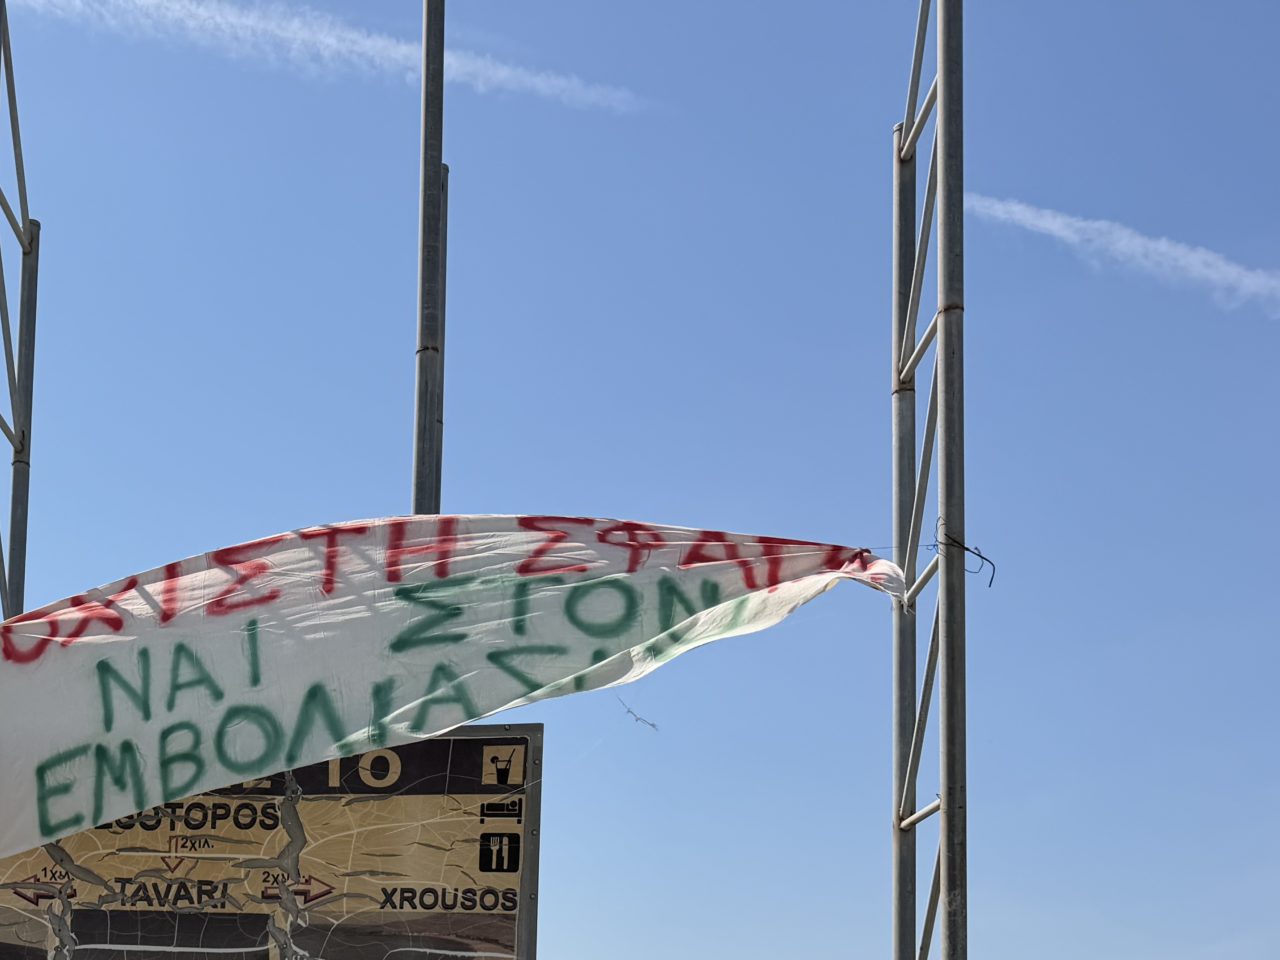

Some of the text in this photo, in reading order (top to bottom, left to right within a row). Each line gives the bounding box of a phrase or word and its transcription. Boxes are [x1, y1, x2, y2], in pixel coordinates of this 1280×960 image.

[95, 619, 261, 733] ΝΑΙ
[114, 877, 229, 909] TAVARI
[379, 887, 518, 912] XROUSOS
